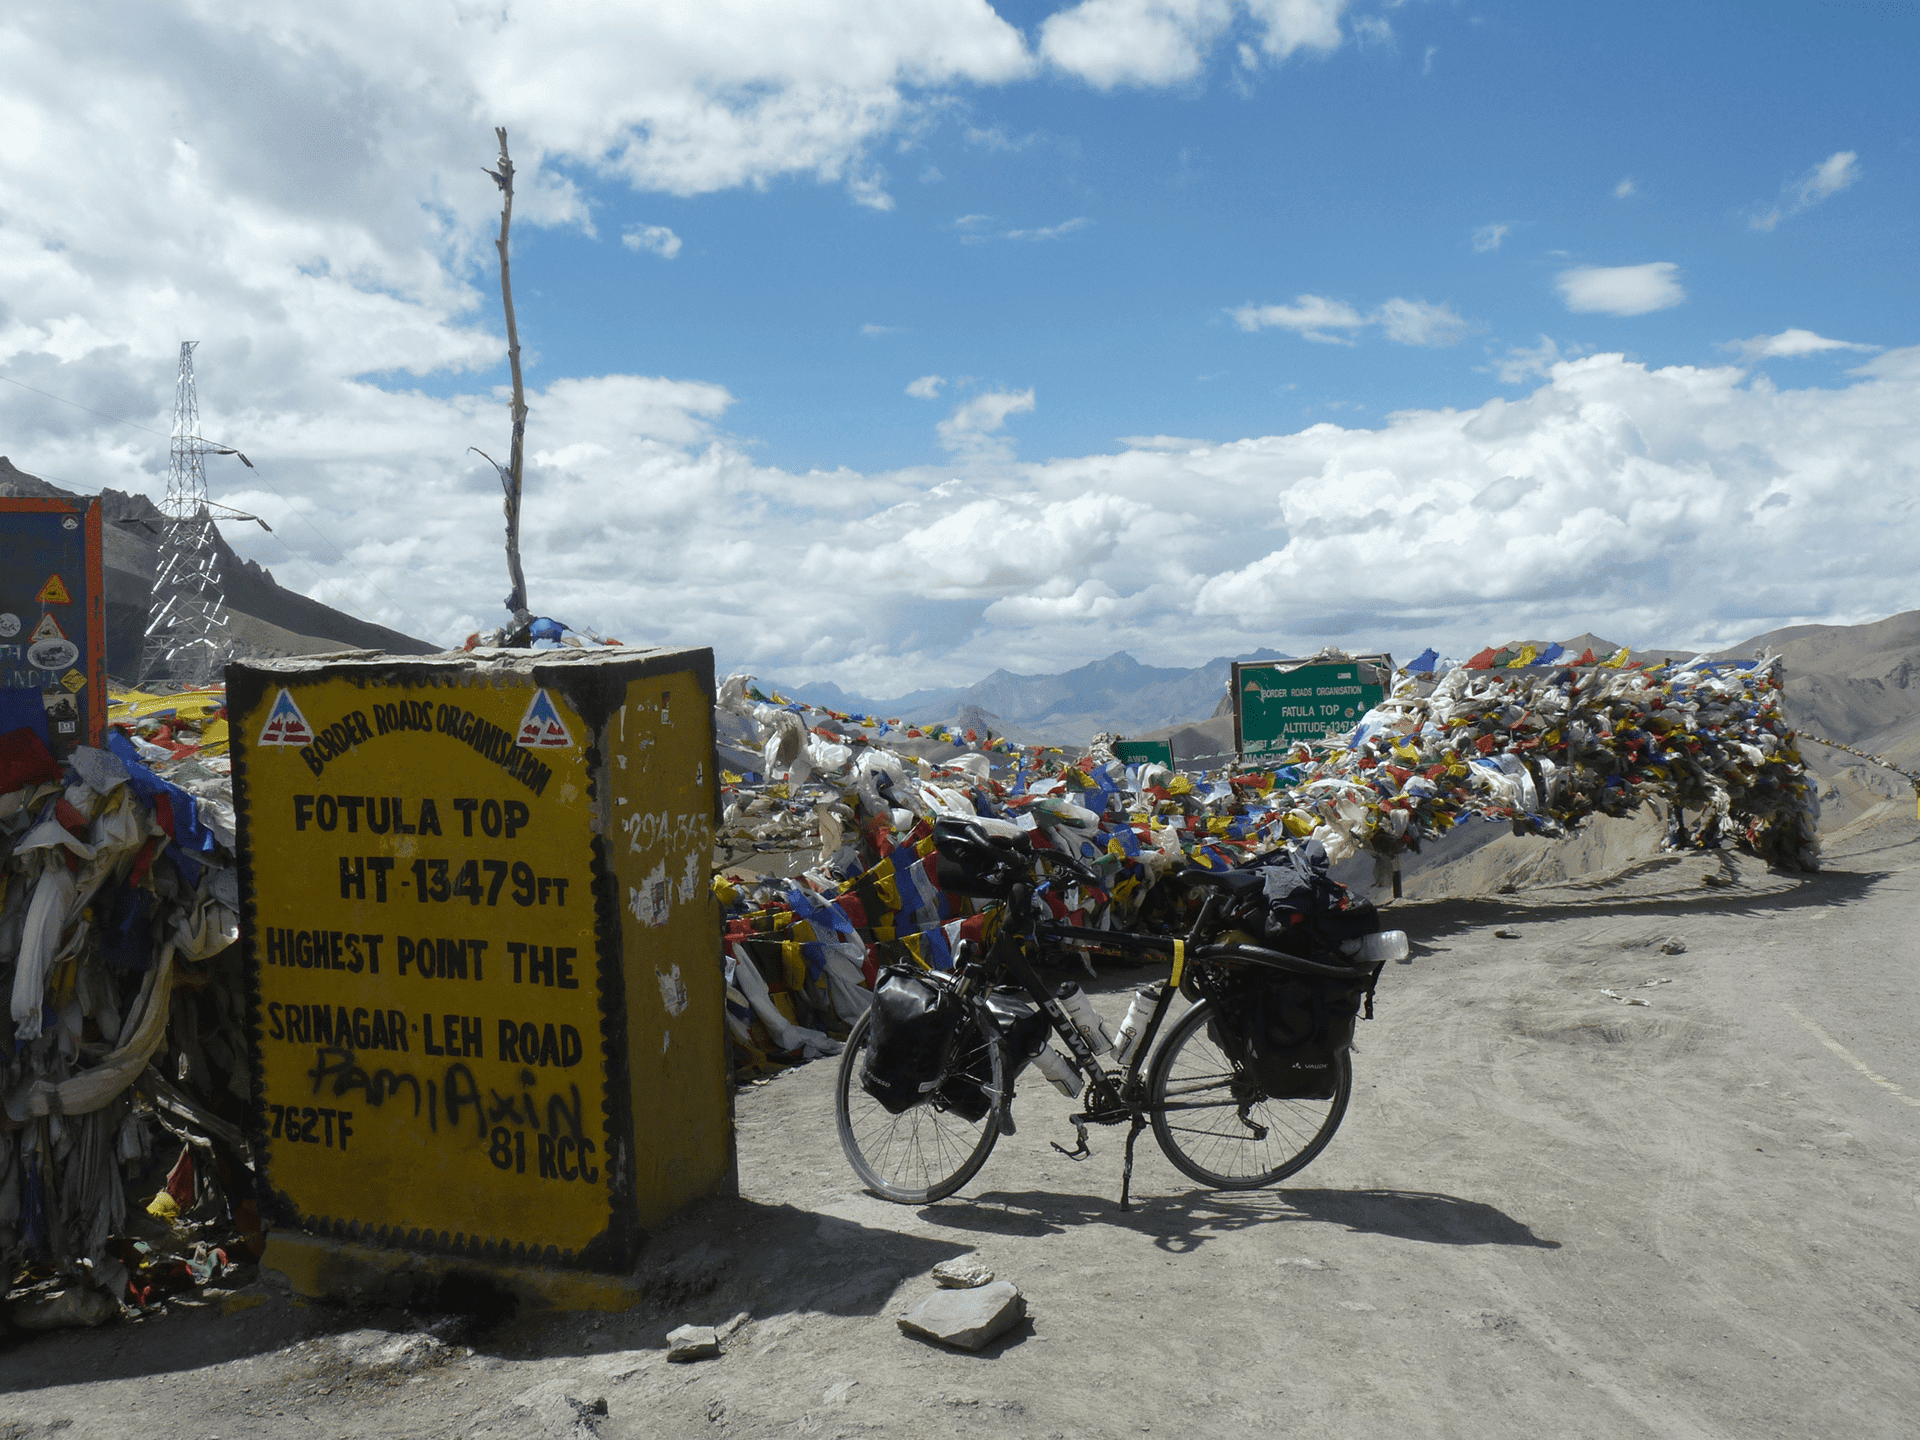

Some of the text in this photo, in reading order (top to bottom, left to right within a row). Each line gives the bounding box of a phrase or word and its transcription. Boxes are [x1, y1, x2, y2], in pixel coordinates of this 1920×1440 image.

[1261, 685, 1363, 699] BORDER ROADS ORGANISATION
[1281, 704, 1340, 717] FATULA TOP
[300, 700, 553, 798] BORDER ROADS ORGANISATION
[293, 794, 530, 839] FOTULA TOP
[266, 927, 579, 990] HIGHEST POINT THE
[498, 1018, 583, 1068] ROAD
[269, 1103, 354, 1151] 762TF
[489, 1125, 600, 1185] 81 RCC
